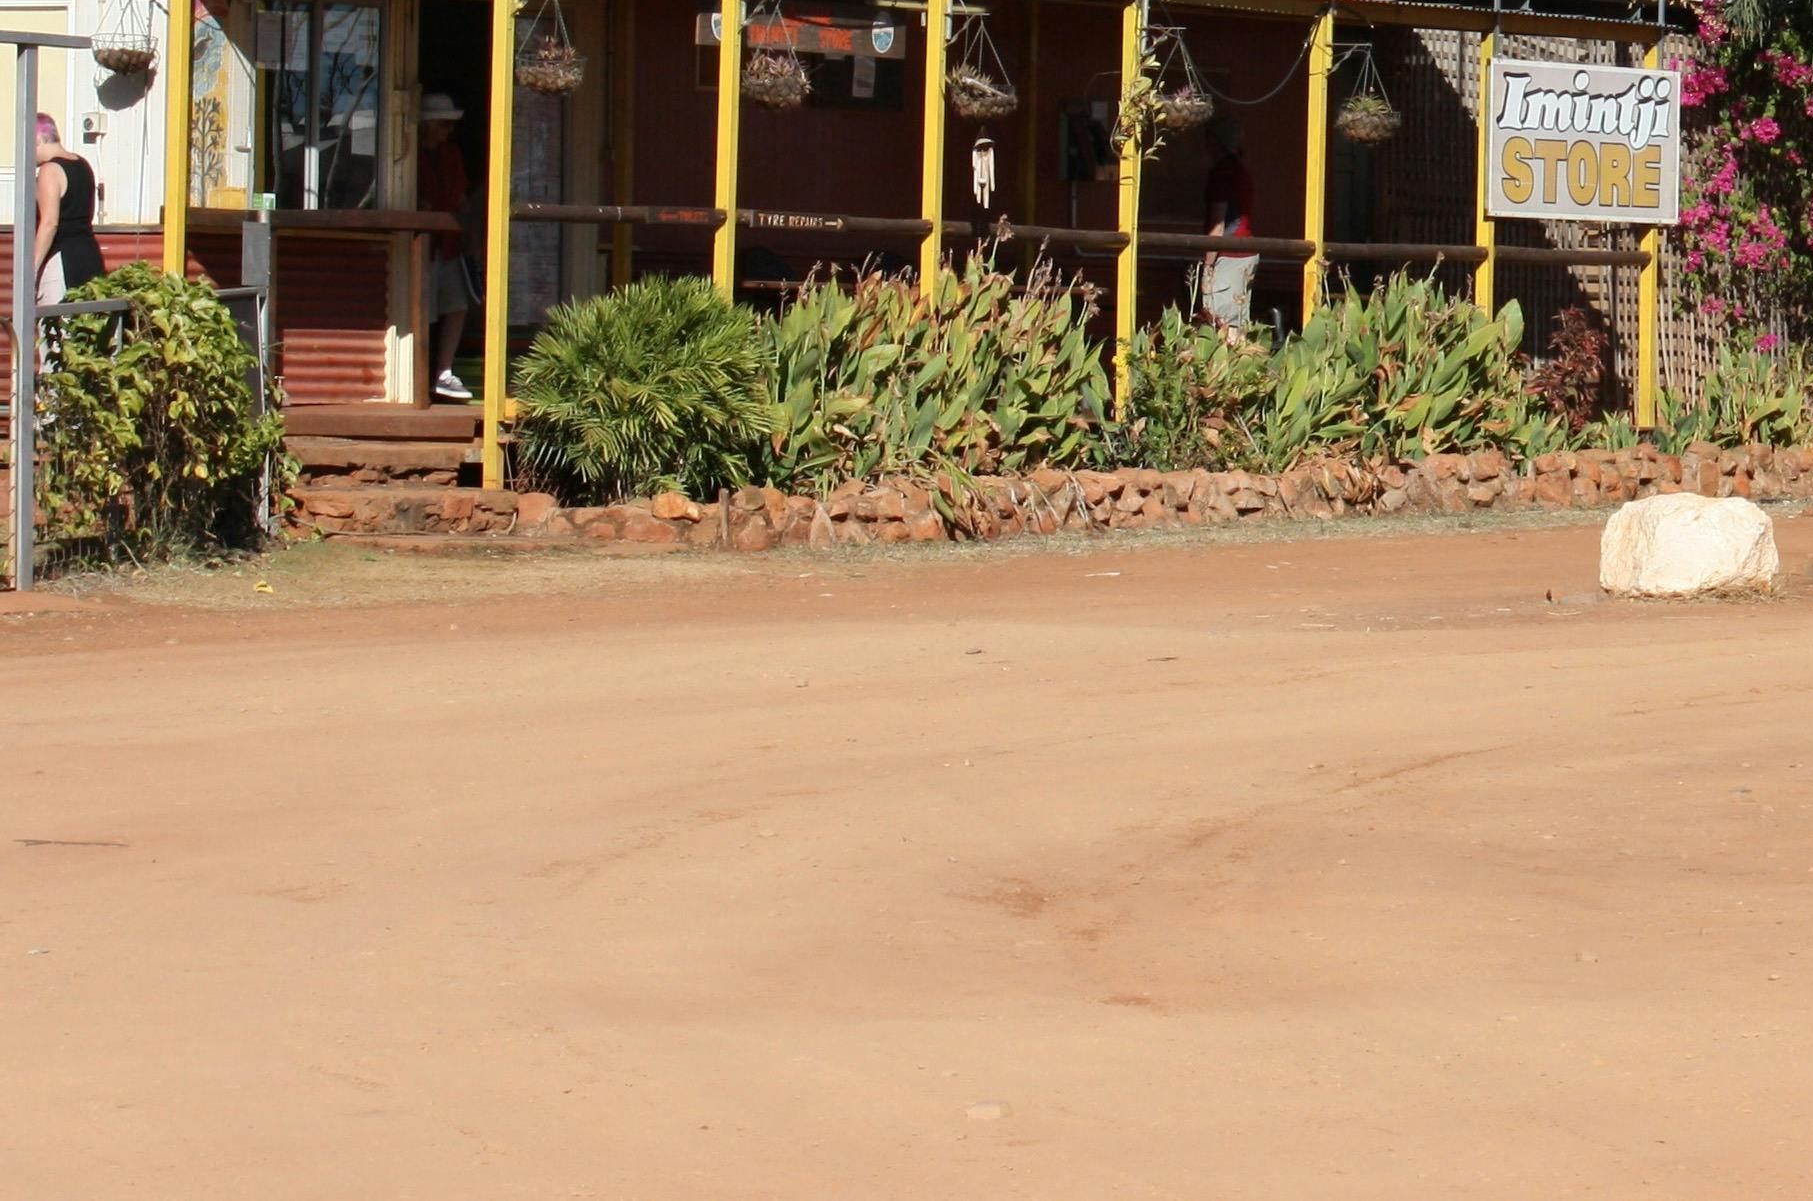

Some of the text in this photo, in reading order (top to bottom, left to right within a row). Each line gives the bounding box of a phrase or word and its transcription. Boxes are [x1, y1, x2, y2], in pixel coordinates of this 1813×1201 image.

[1496, 69, 1672, 150] Imintji
[1501, 136, 1662, 209] STORE
[758, 212, 823, 230] TYRE REPAIRS
